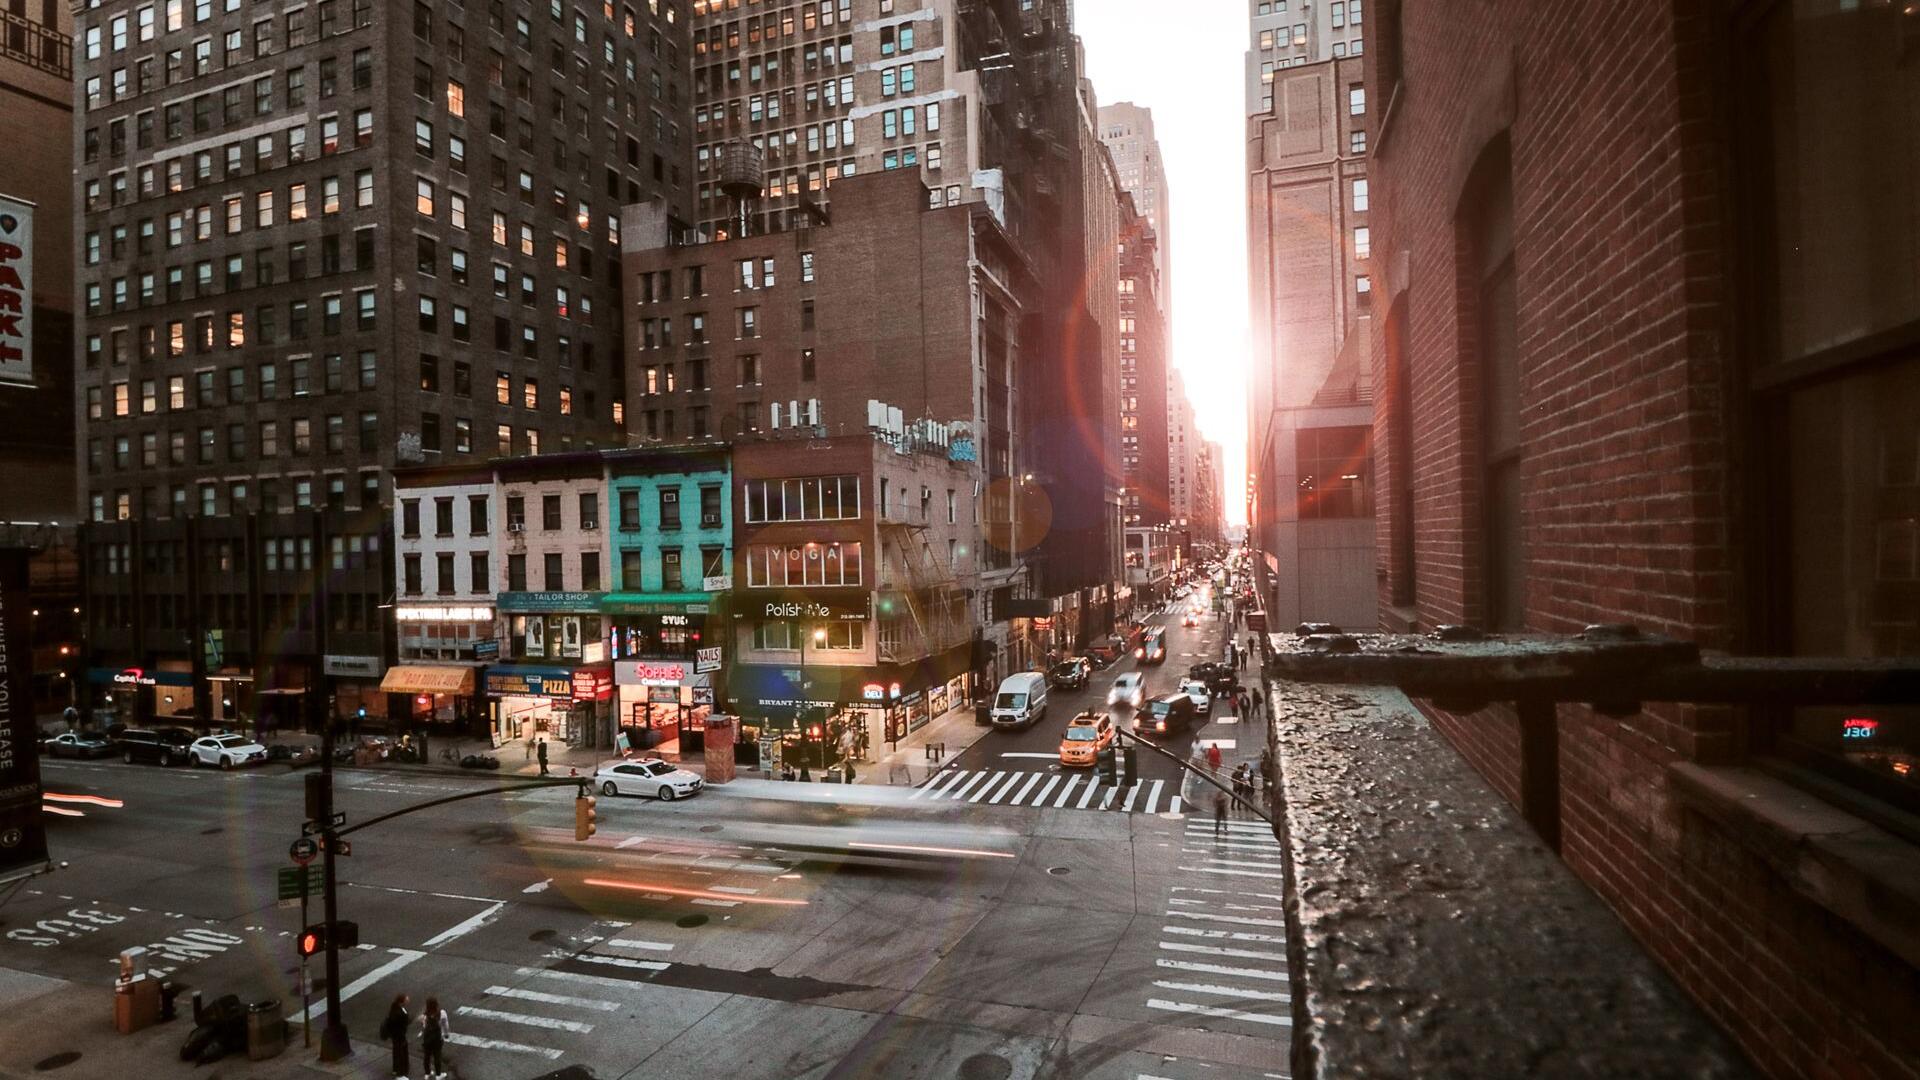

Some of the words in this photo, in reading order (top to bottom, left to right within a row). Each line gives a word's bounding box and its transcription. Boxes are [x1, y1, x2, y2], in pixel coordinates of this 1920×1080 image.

[772, 549, 837, 561] YOGA
[697, 648, 719, 662] NAILS
[542, 680, 570, 694] PIZZA
[0, 718, 14, 769] LEASE
